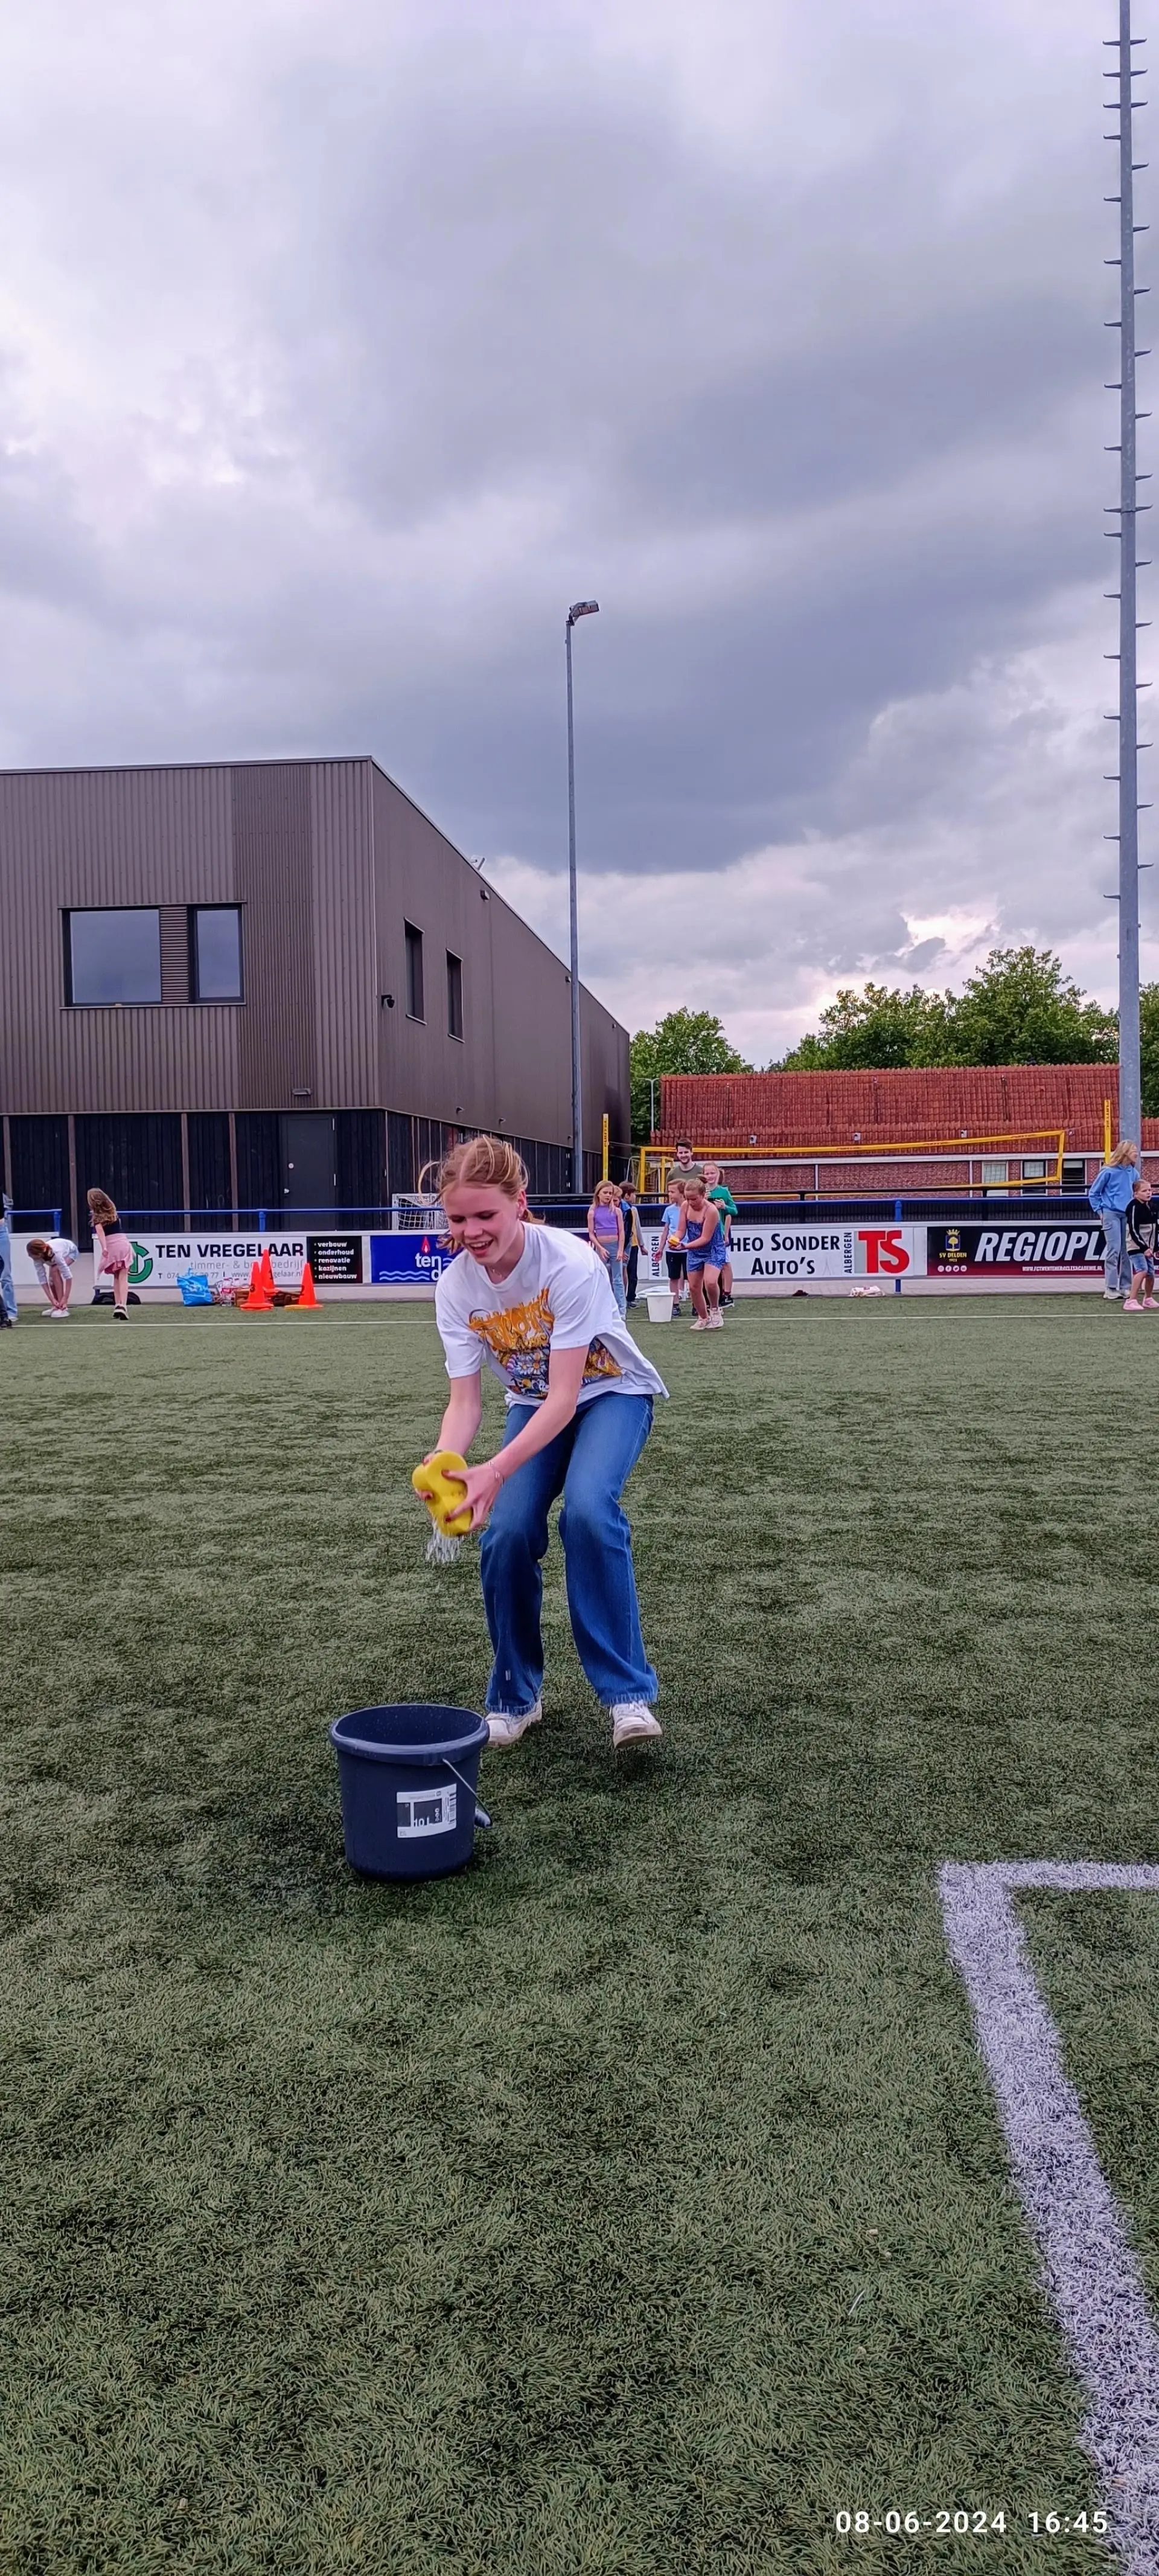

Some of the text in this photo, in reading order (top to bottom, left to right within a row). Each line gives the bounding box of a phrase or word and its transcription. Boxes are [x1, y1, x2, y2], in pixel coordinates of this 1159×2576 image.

[156, 1243, 304, 1258] TEN VREGELAAR
[730, 1237, 763, 1252] HEO
[858, 1230, 910, 1274] TS
[974, 1231, 1107, 1261] REGIOPL
[415, 1252, 442, 1268] ten
[844, 1232, 852, 1274] ALBERGEN
[233, 1260, 240, 1269] &
[249, 1283, 256, 1293] 3
